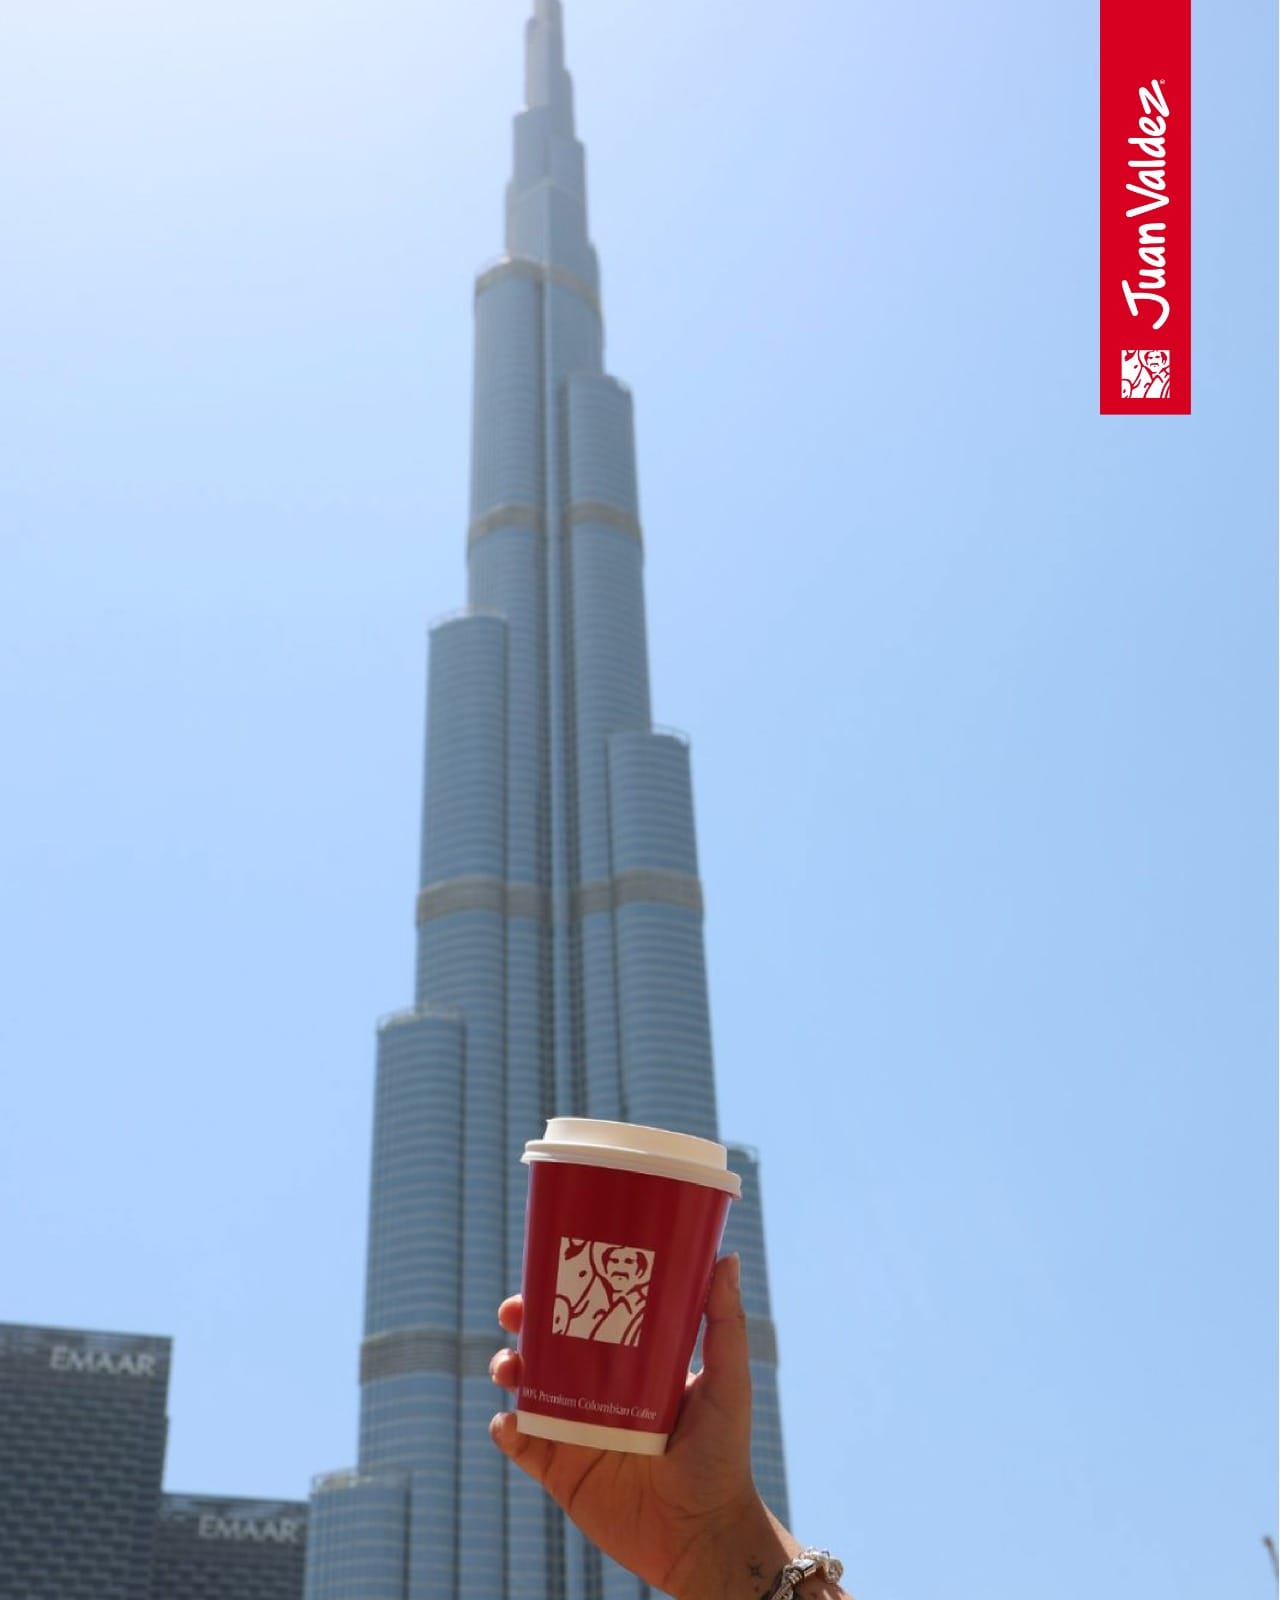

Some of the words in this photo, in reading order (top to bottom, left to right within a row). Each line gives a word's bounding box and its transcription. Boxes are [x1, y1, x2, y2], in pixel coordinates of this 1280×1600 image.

[50, 1346, 157, 1376] EMAAR
[539, 1390, 577, 1408] Premium
[578, 1397, 629, 1416] Colombian
[630, 1406, 656, 1420] Coffee
[198, 1515, 299, 1543] EMAAR
